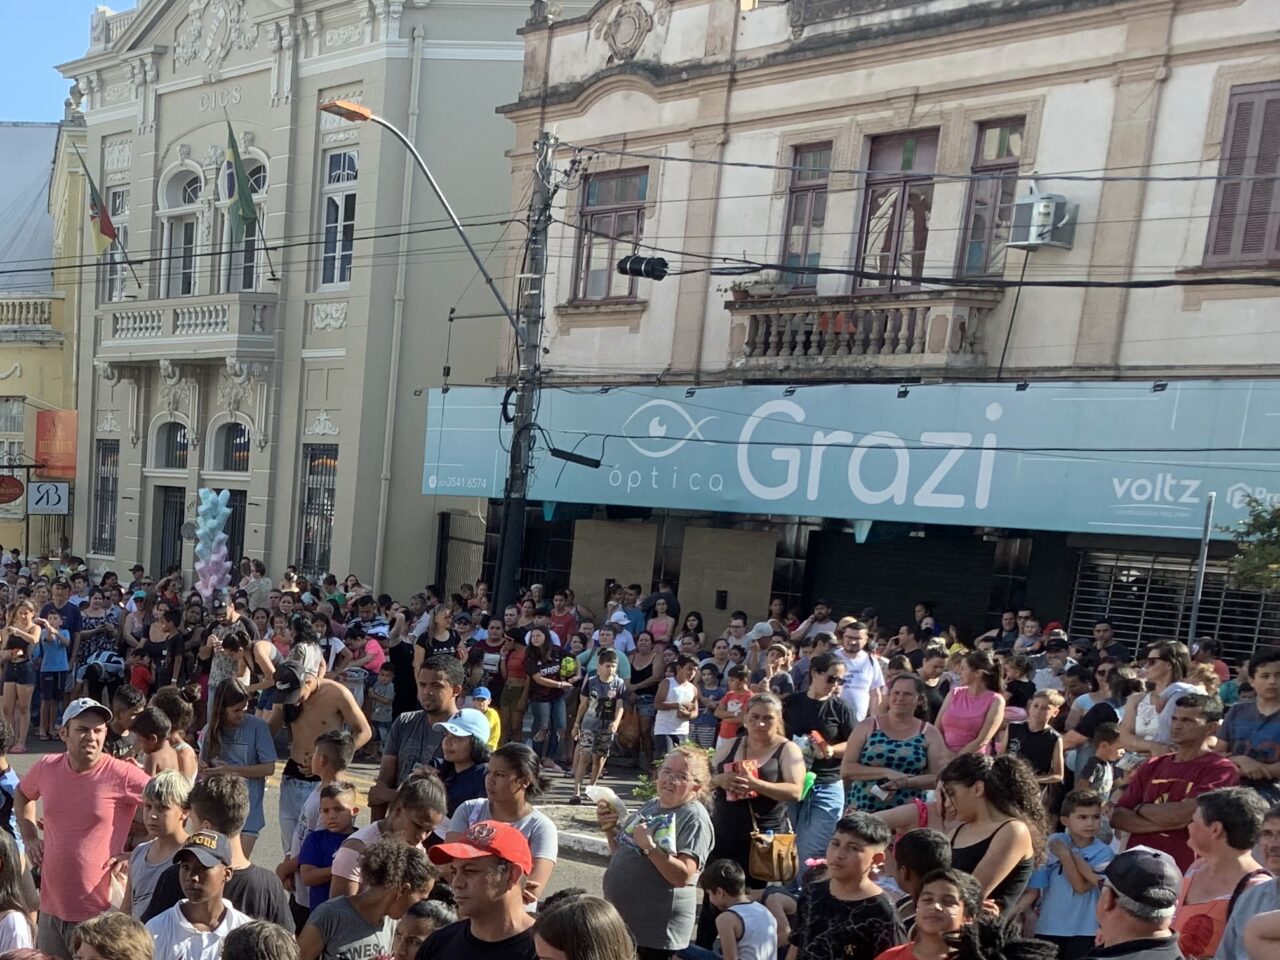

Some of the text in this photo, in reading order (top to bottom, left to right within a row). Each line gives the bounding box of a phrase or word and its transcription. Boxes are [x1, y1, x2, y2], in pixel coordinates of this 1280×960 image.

[200, 86, 241, 112] CICS
[737, 399, 1003, 509] Grazi
[608, 463, 724, 493] óptica
[1112, 473, 1202, 503] voltz
